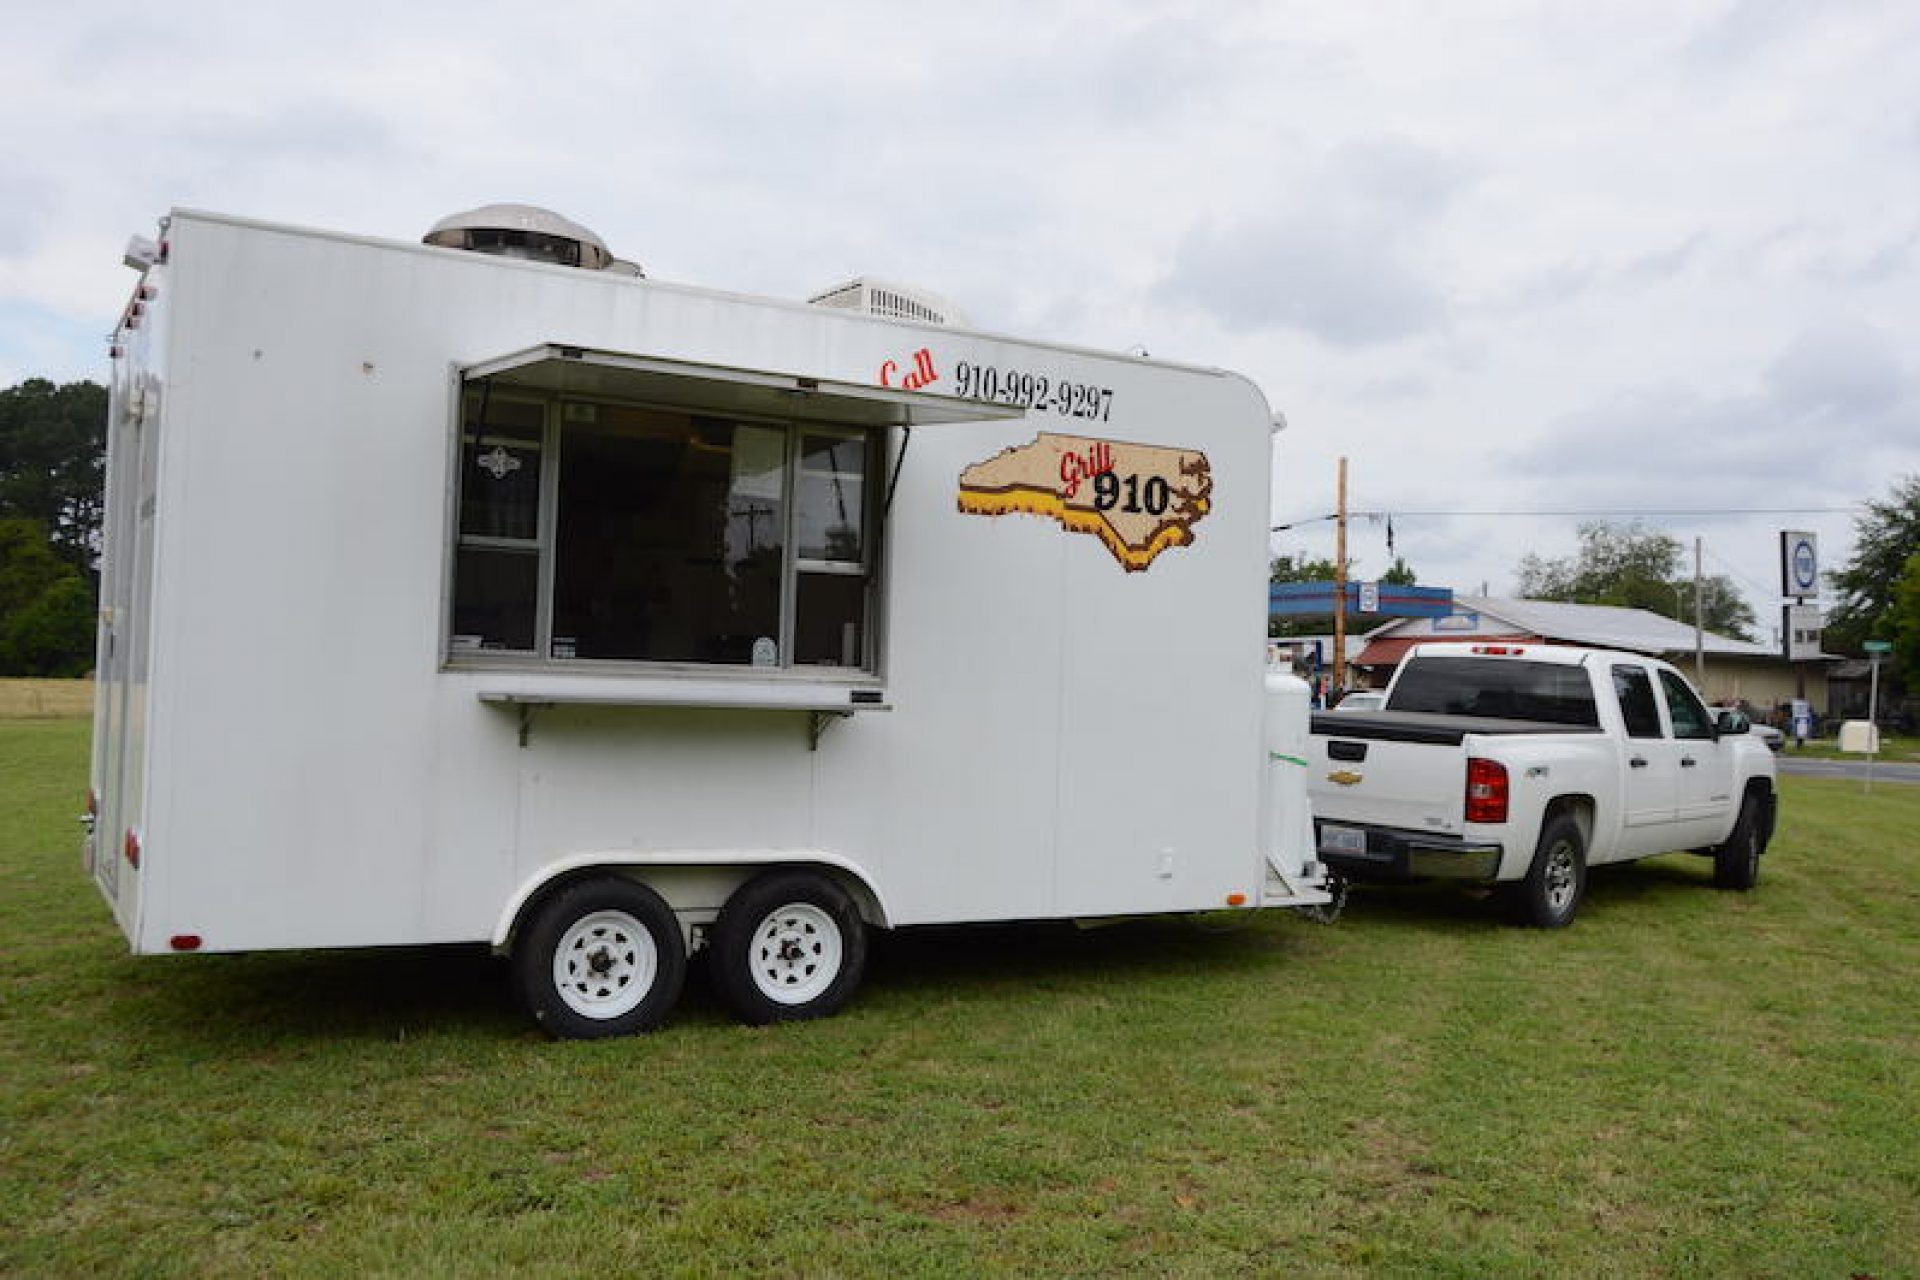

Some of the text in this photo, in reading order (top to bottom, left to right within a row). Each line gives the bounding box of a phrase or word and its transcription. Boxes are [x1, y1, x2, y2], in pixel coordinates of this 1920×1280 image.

[955, 360, 1114, 422] 910-992-9297
[1060, 442, 1116, 499] Grill
[1095, 474, 1168, 516] 910
